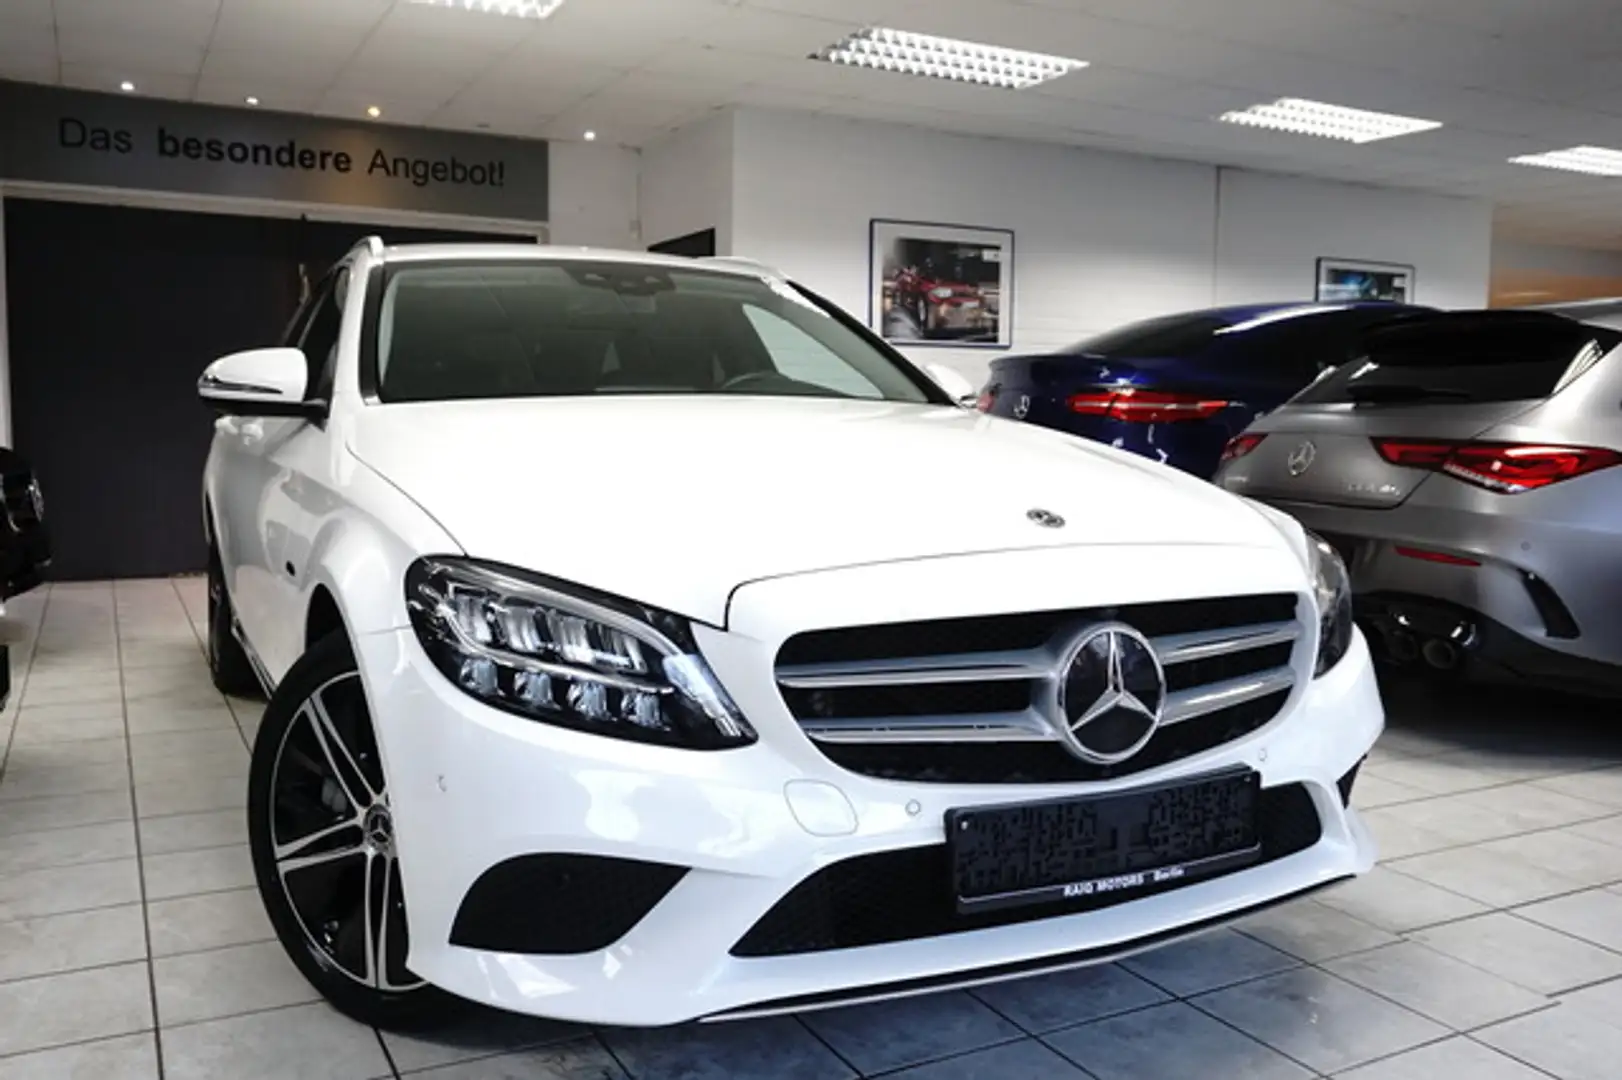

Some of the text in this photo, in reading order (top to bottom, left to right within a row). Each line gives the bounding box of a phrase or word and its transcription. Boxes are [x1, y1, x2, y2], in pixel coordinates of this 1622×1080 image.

[58, 117, 504, 188] Das besondere Angebot!
[1097, 873, 1144, 891] MOTORS
